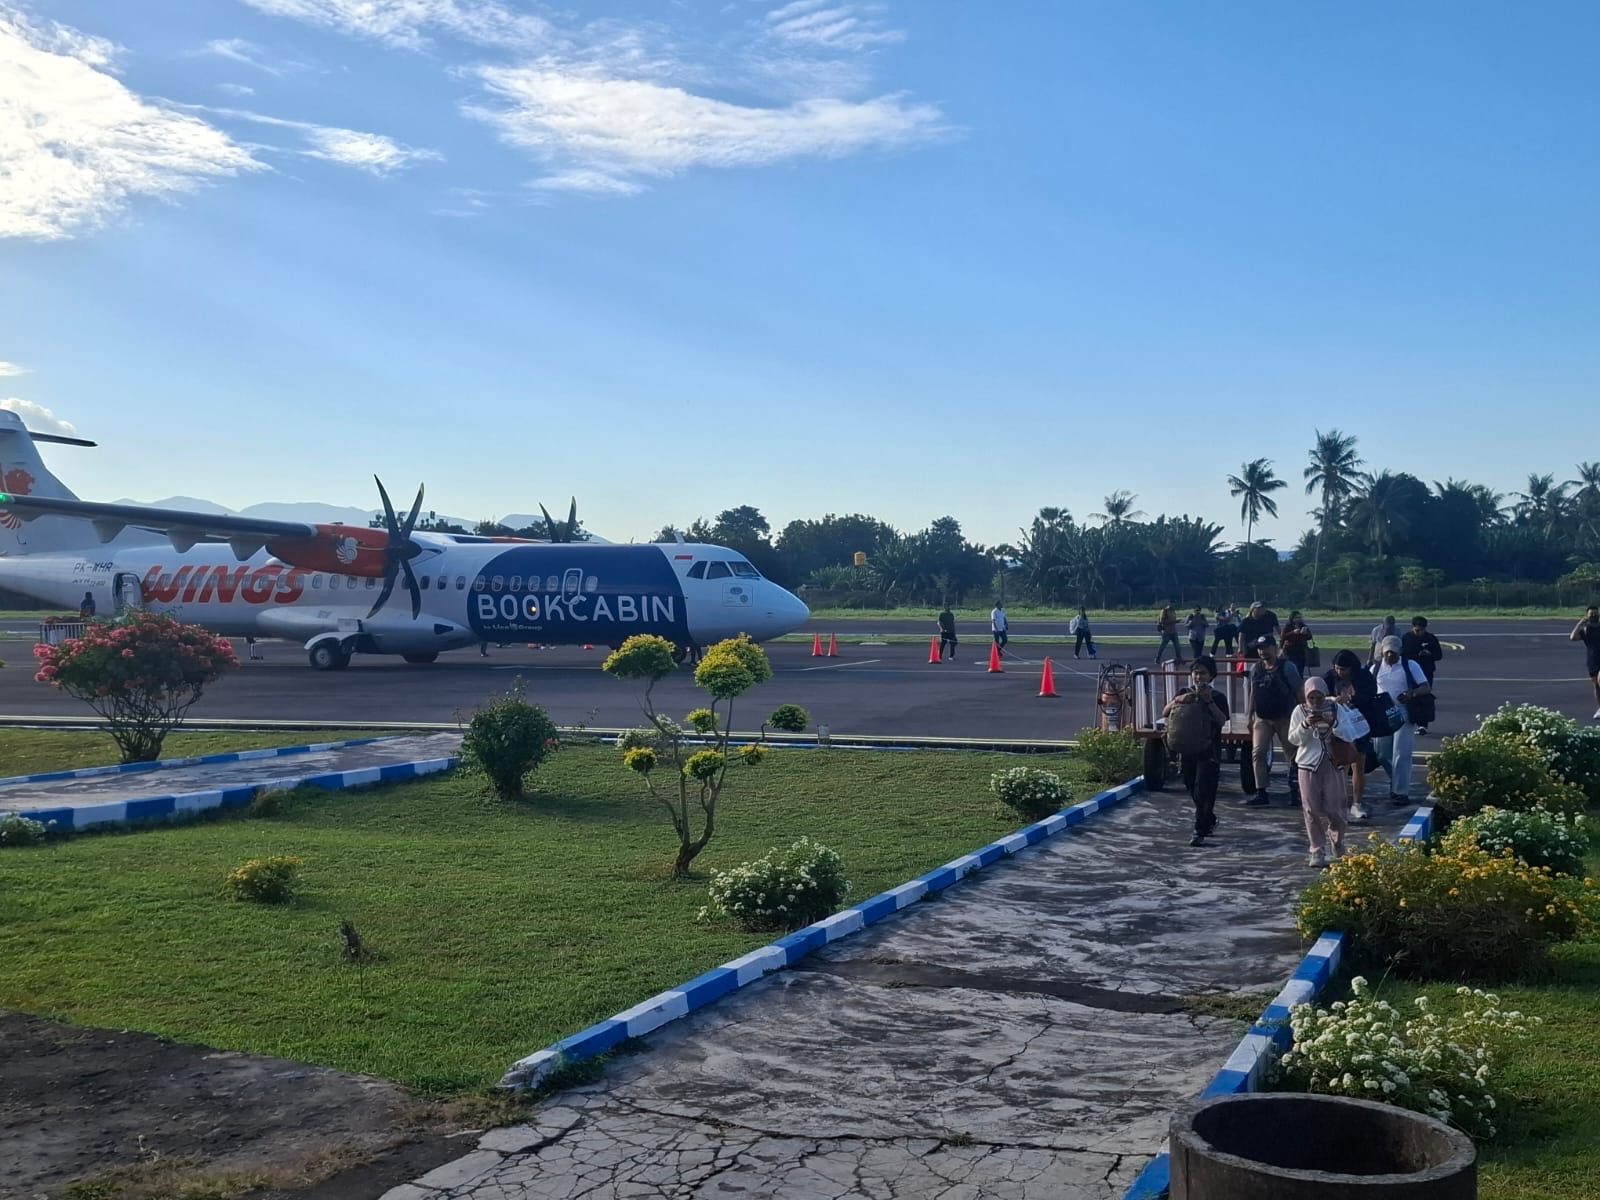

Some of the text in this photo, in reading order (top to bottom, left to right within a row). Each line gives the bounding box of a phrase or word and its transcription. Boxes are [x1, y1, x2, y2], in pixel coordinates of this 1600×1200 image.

[73, 561, 113, 573] PK-WHR
[141, 564, 312, 604] WINGS
[477, 593, 675, 622] BOOKCABIN
